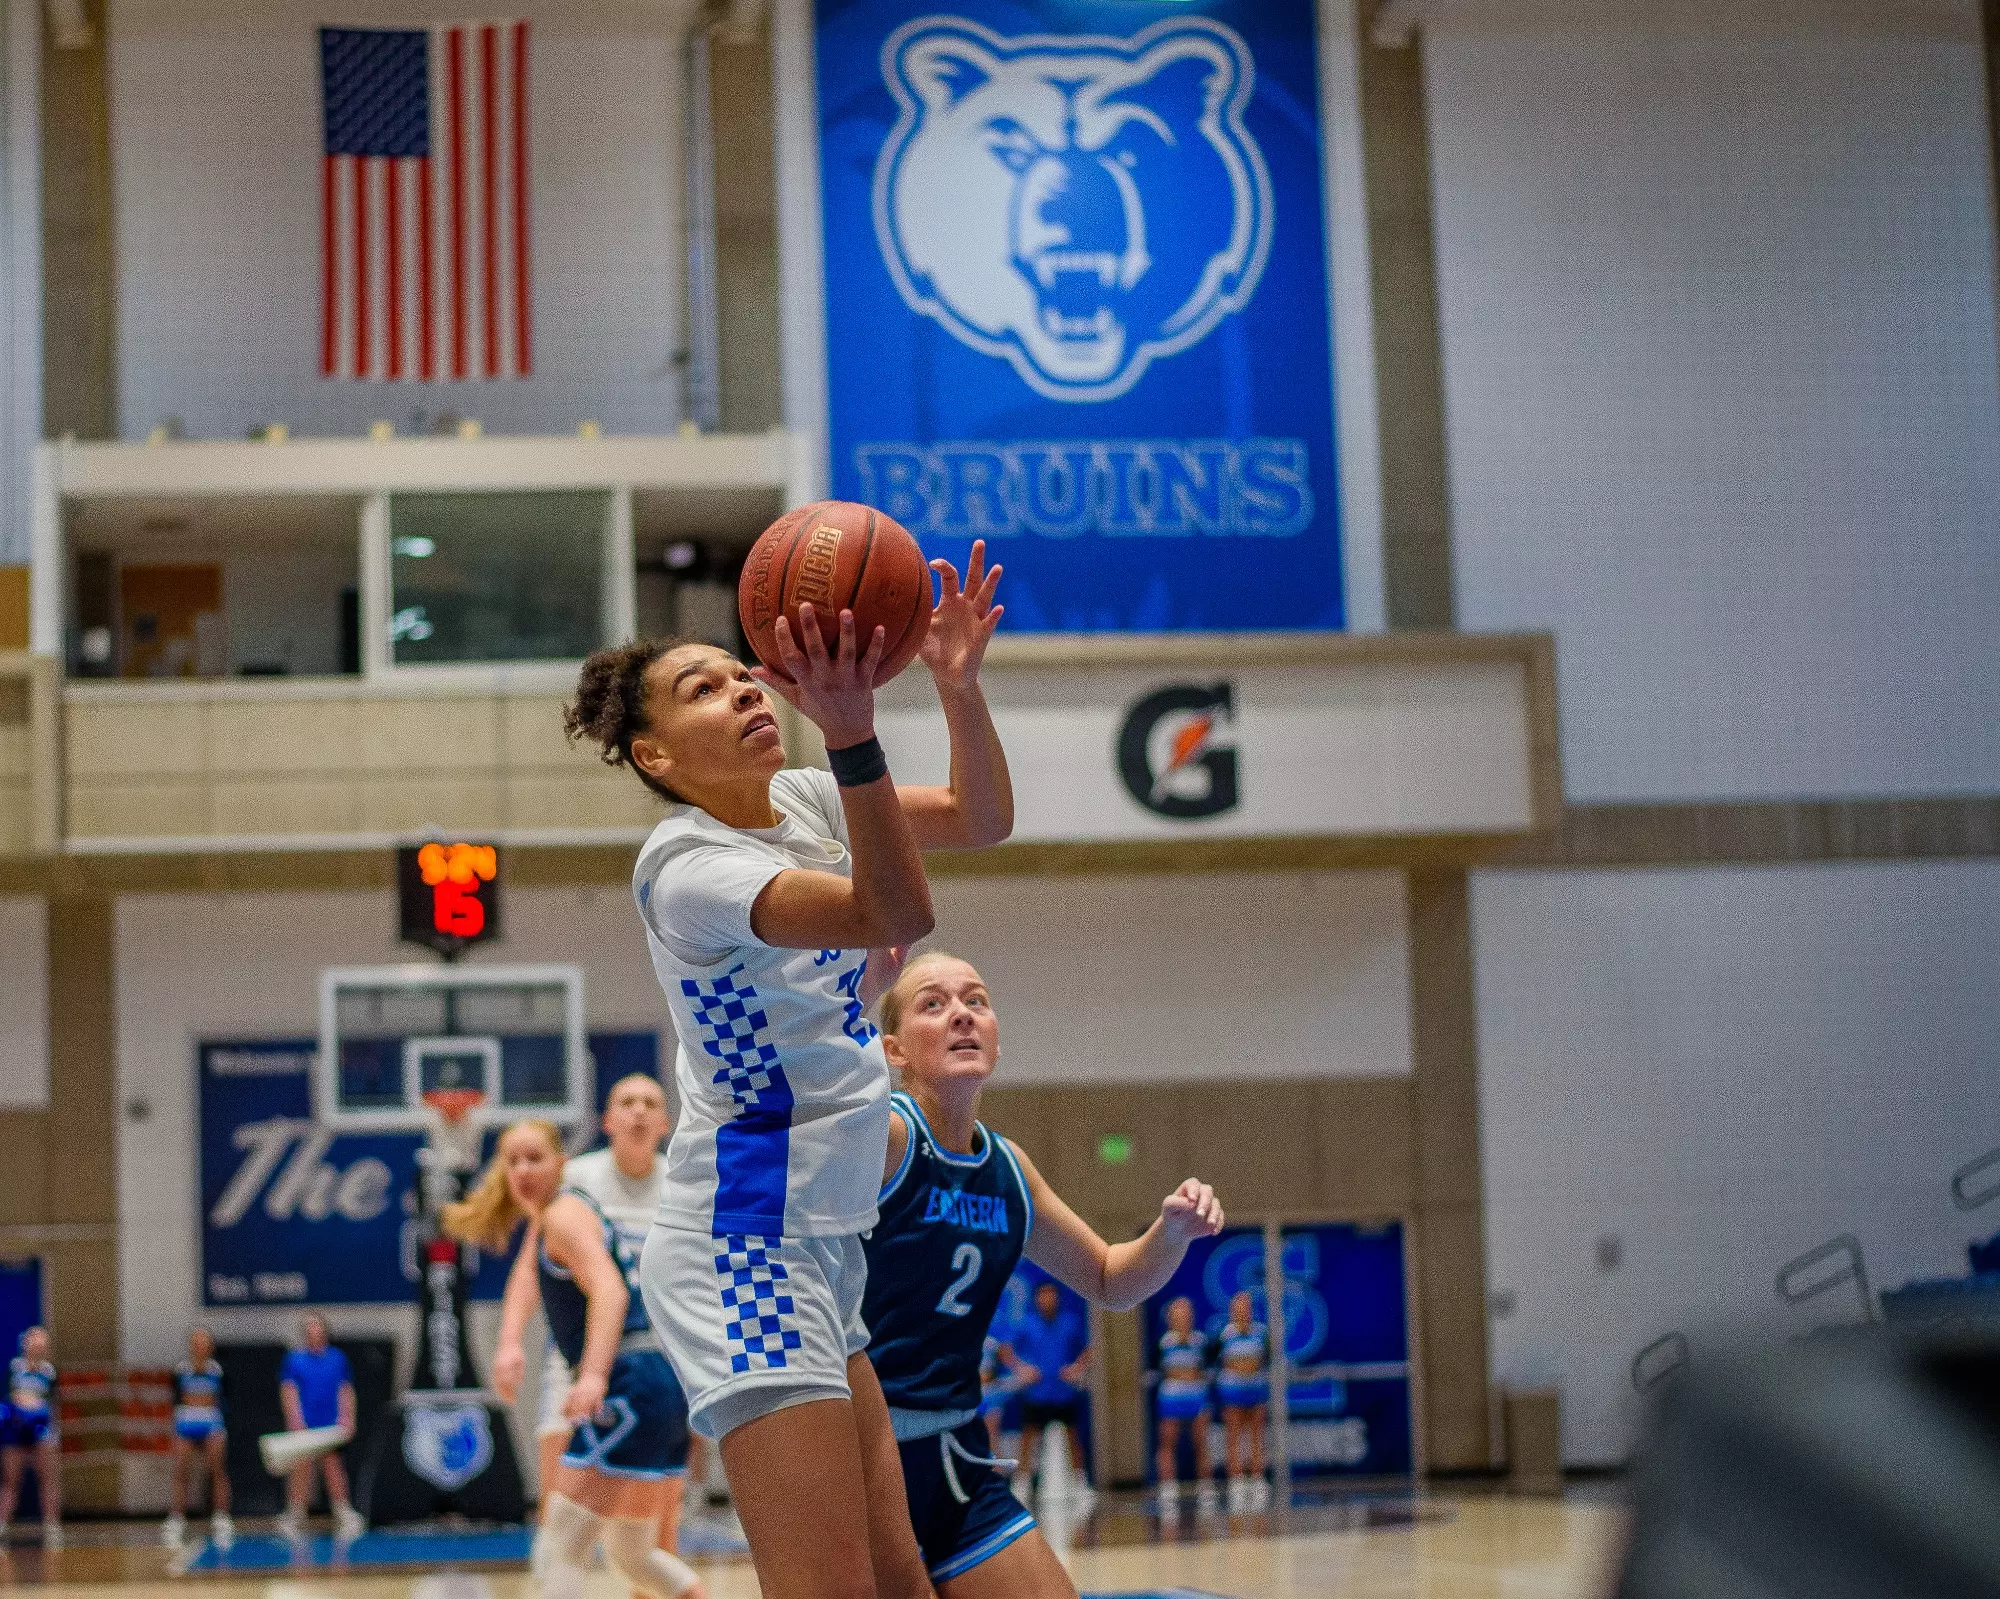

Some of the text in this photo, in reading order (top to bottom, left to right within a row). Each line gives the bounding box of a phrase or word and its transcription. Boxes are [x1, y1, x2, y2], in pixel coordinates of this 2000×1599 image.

[853, 439, 1315, 539] BRUINS
[752, 510, 809, 631] SPALDING
[792, 527, 840, 613] NJCAA
[1116, 681, 1240, 819] G
[209, 1117, 392, 1228] The
[936, 1242, 982, 1316] 2
